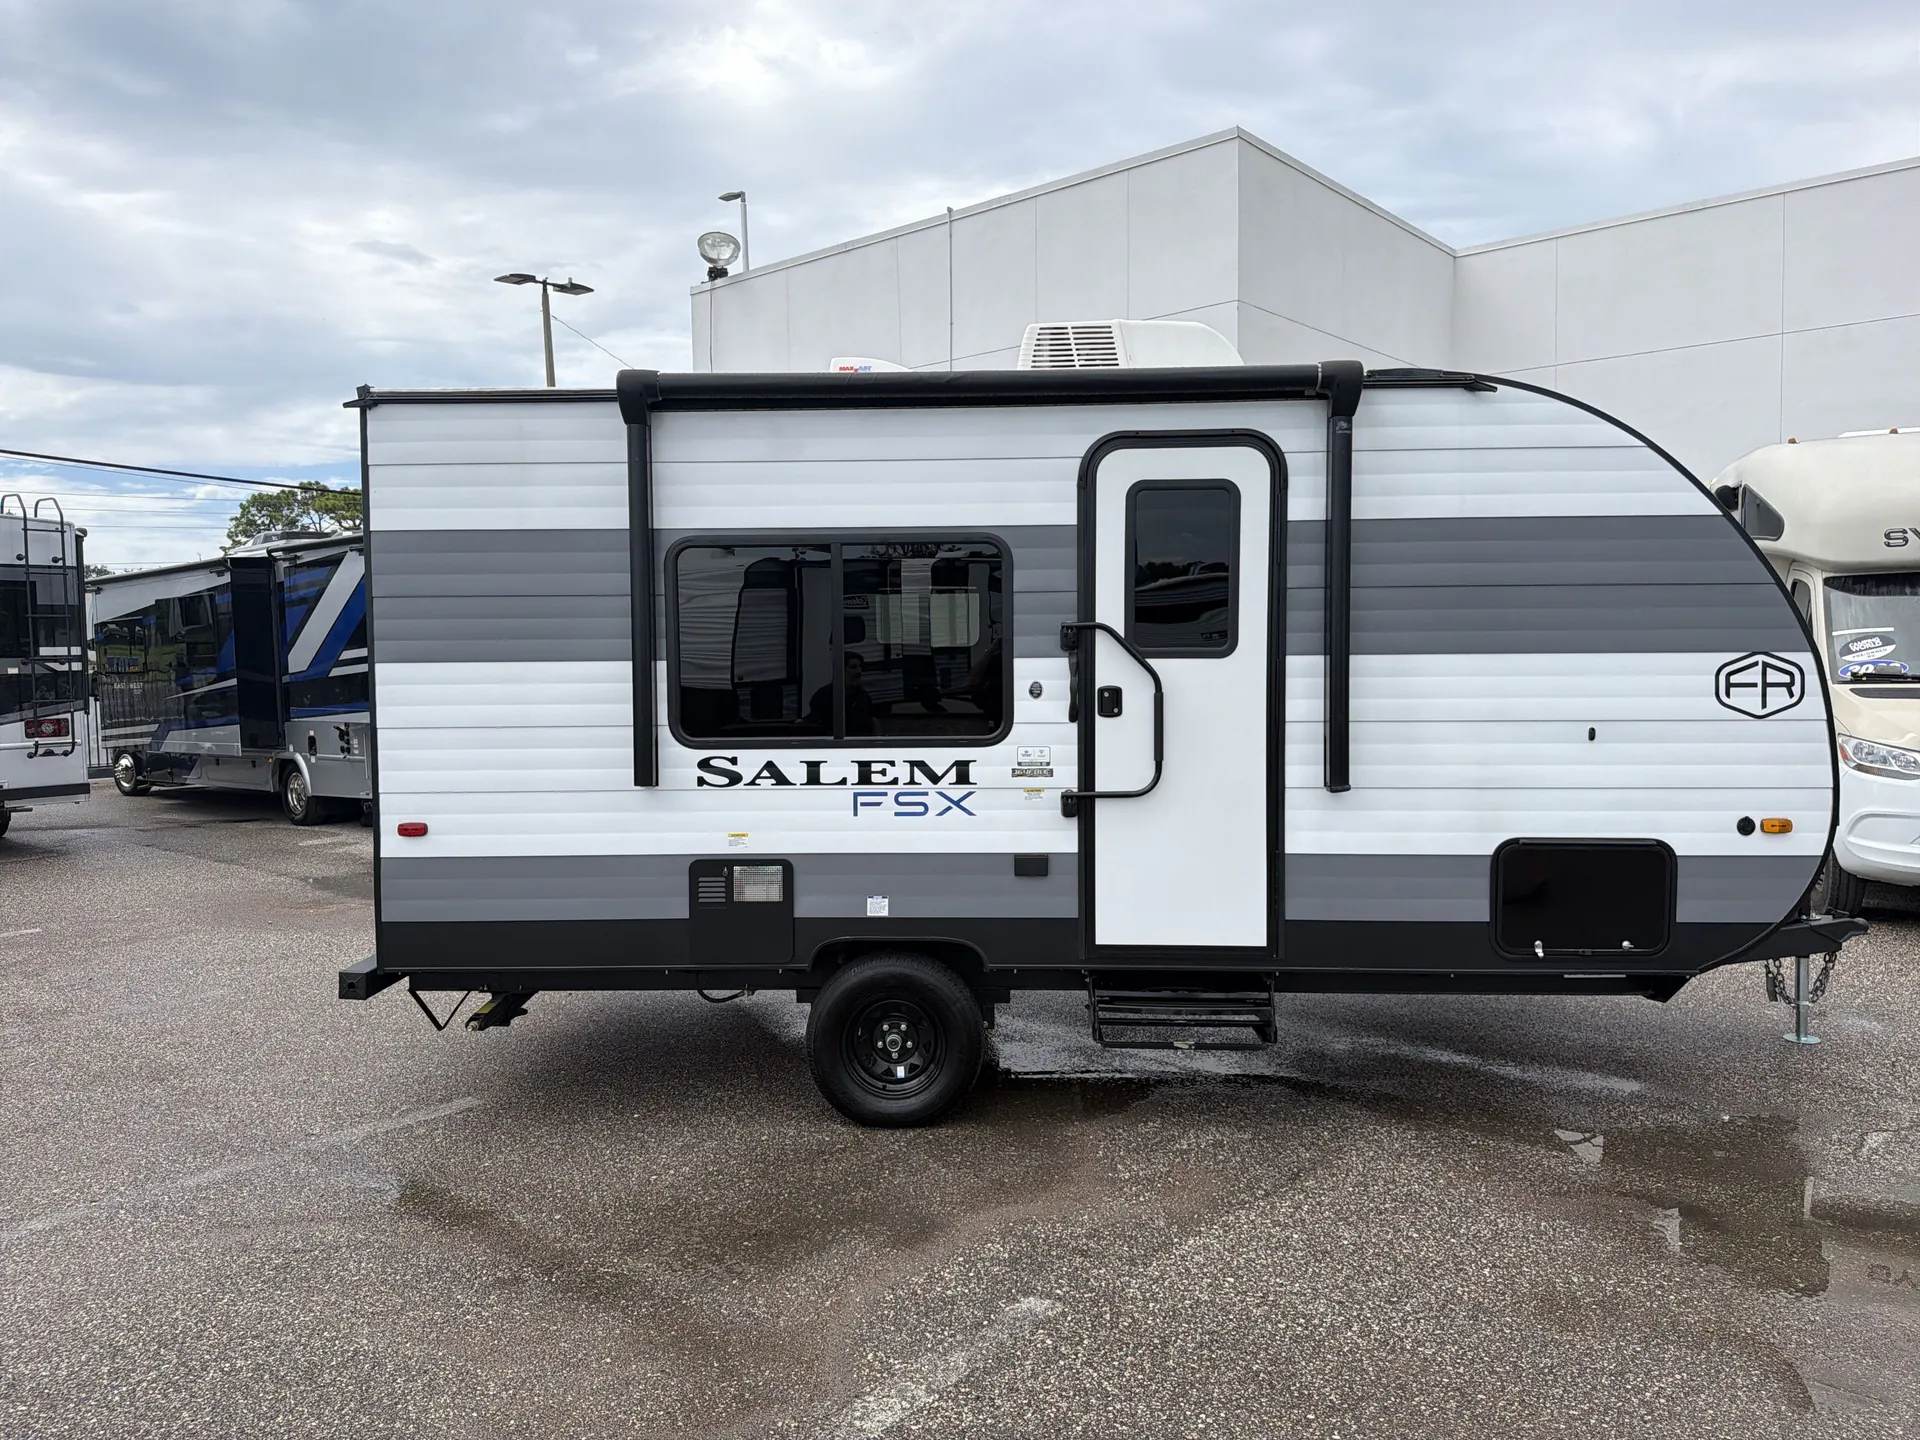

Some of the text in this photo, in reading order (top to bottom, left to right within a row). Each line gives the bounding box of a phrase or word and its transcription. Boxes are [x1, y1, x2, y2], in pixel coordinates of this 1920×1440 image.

[1849, 637, 1881, 649] CAMPING
[1851, 639, 1883, 652] WORLD
[1846, 663, 1904, 677] 20
[697, 755, 978, 788] SALEM
[853, 791, 977, 817] FSX
